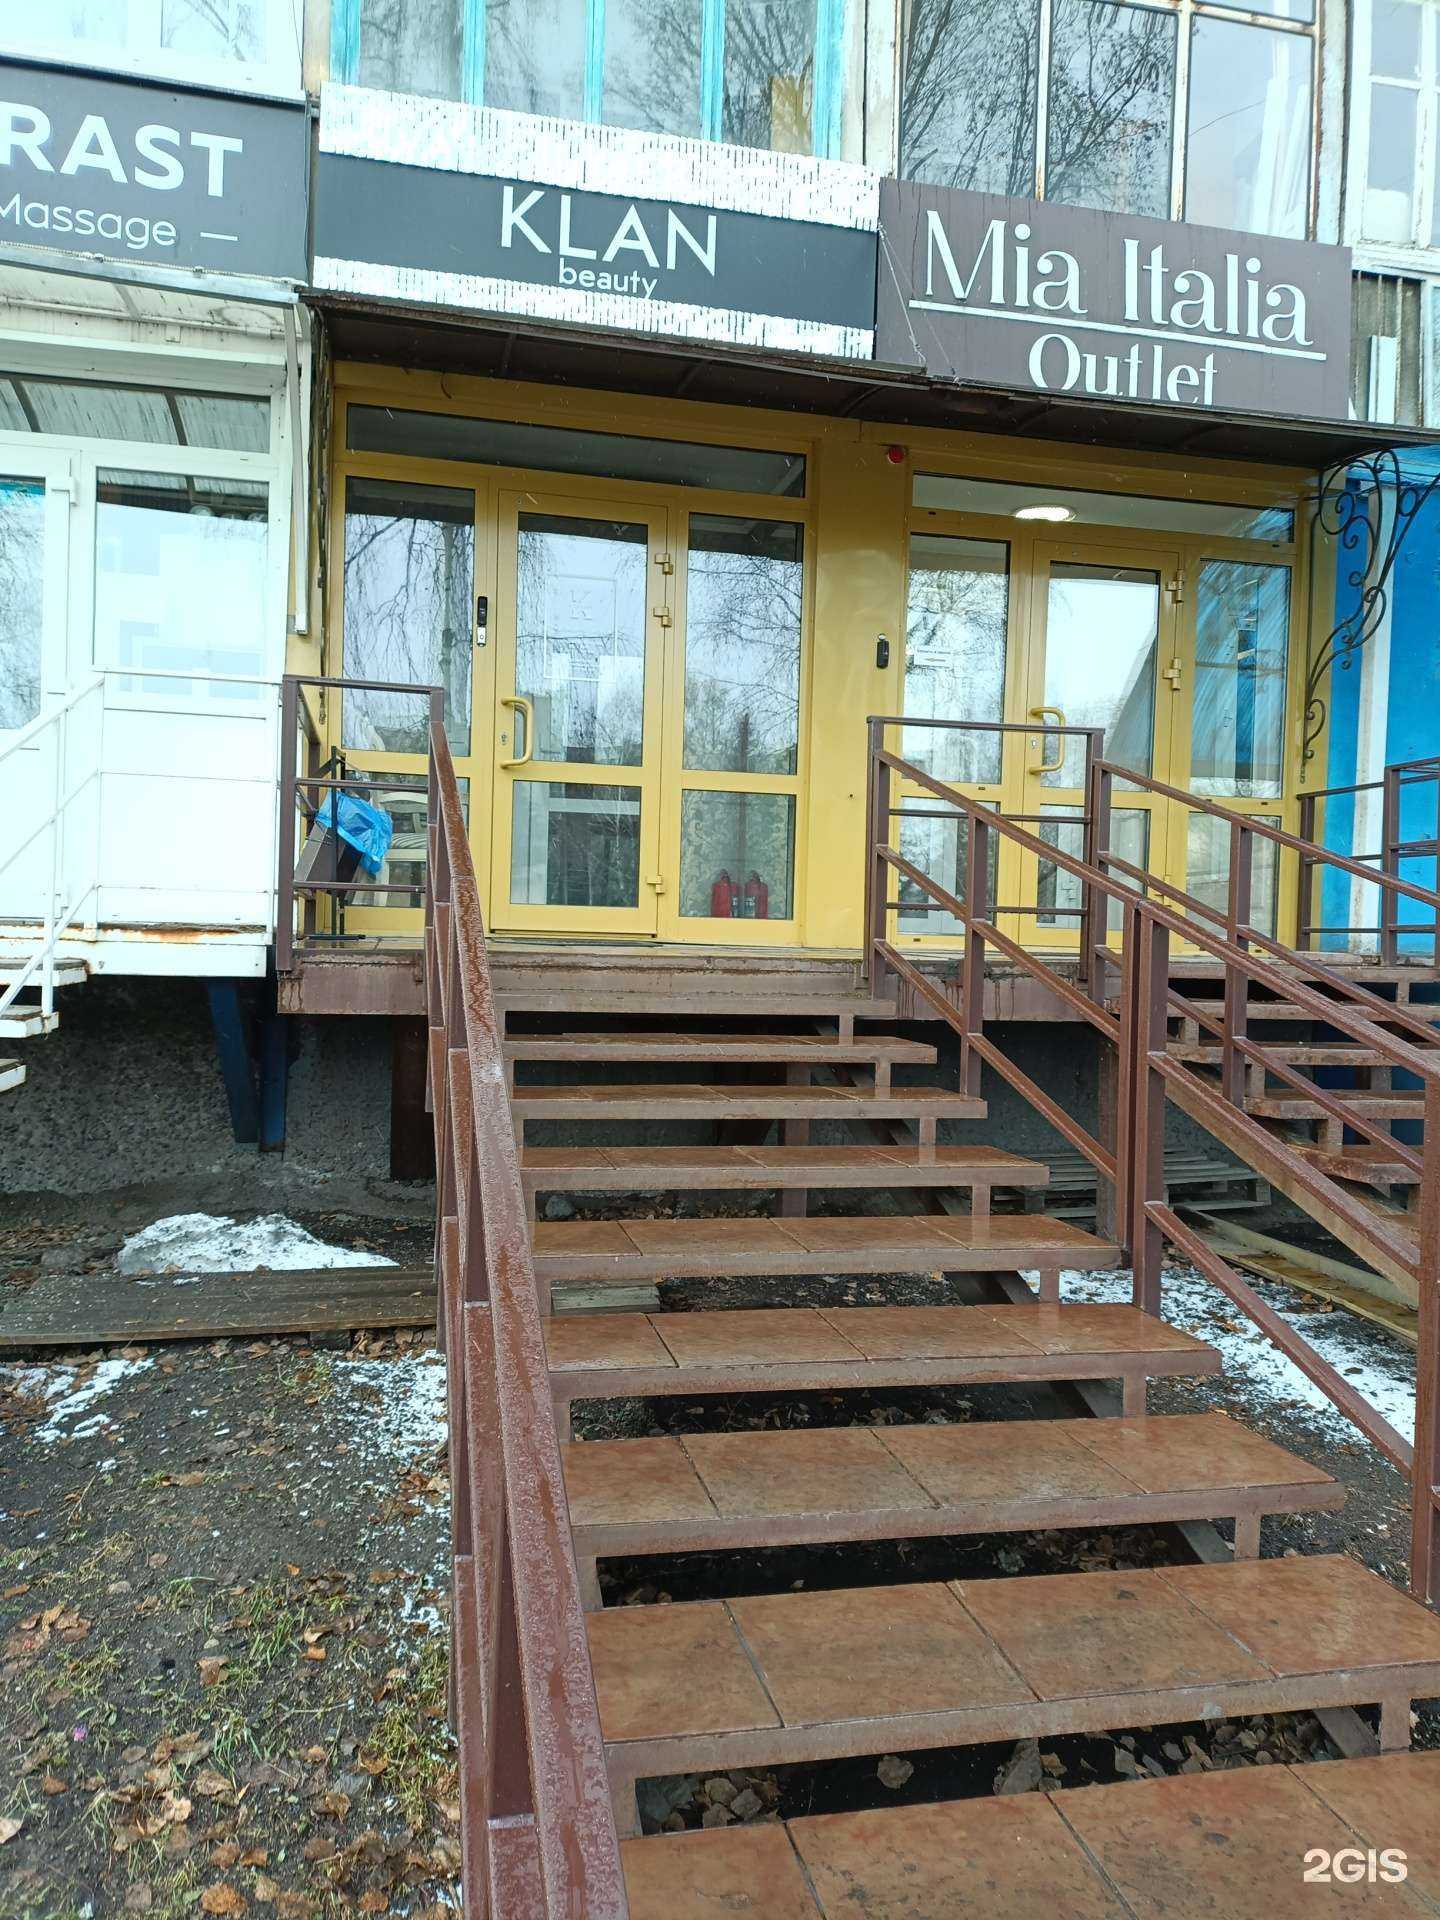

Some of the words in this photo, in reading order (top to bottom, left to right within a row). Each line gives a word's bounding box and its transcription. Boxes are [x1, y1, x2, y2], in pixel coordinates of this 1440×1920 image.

[0, 101, 243, 198] RAST
[0, 192, 177, 250] Massage
[501, 185, 717, 277] KLAN
[558, 258, 658, 299] beauty
[925, 209, 1088, 315] Mia
[1123, 238, 1314, 347] Italia
[1028, 333, 1218, 406] Outlet
